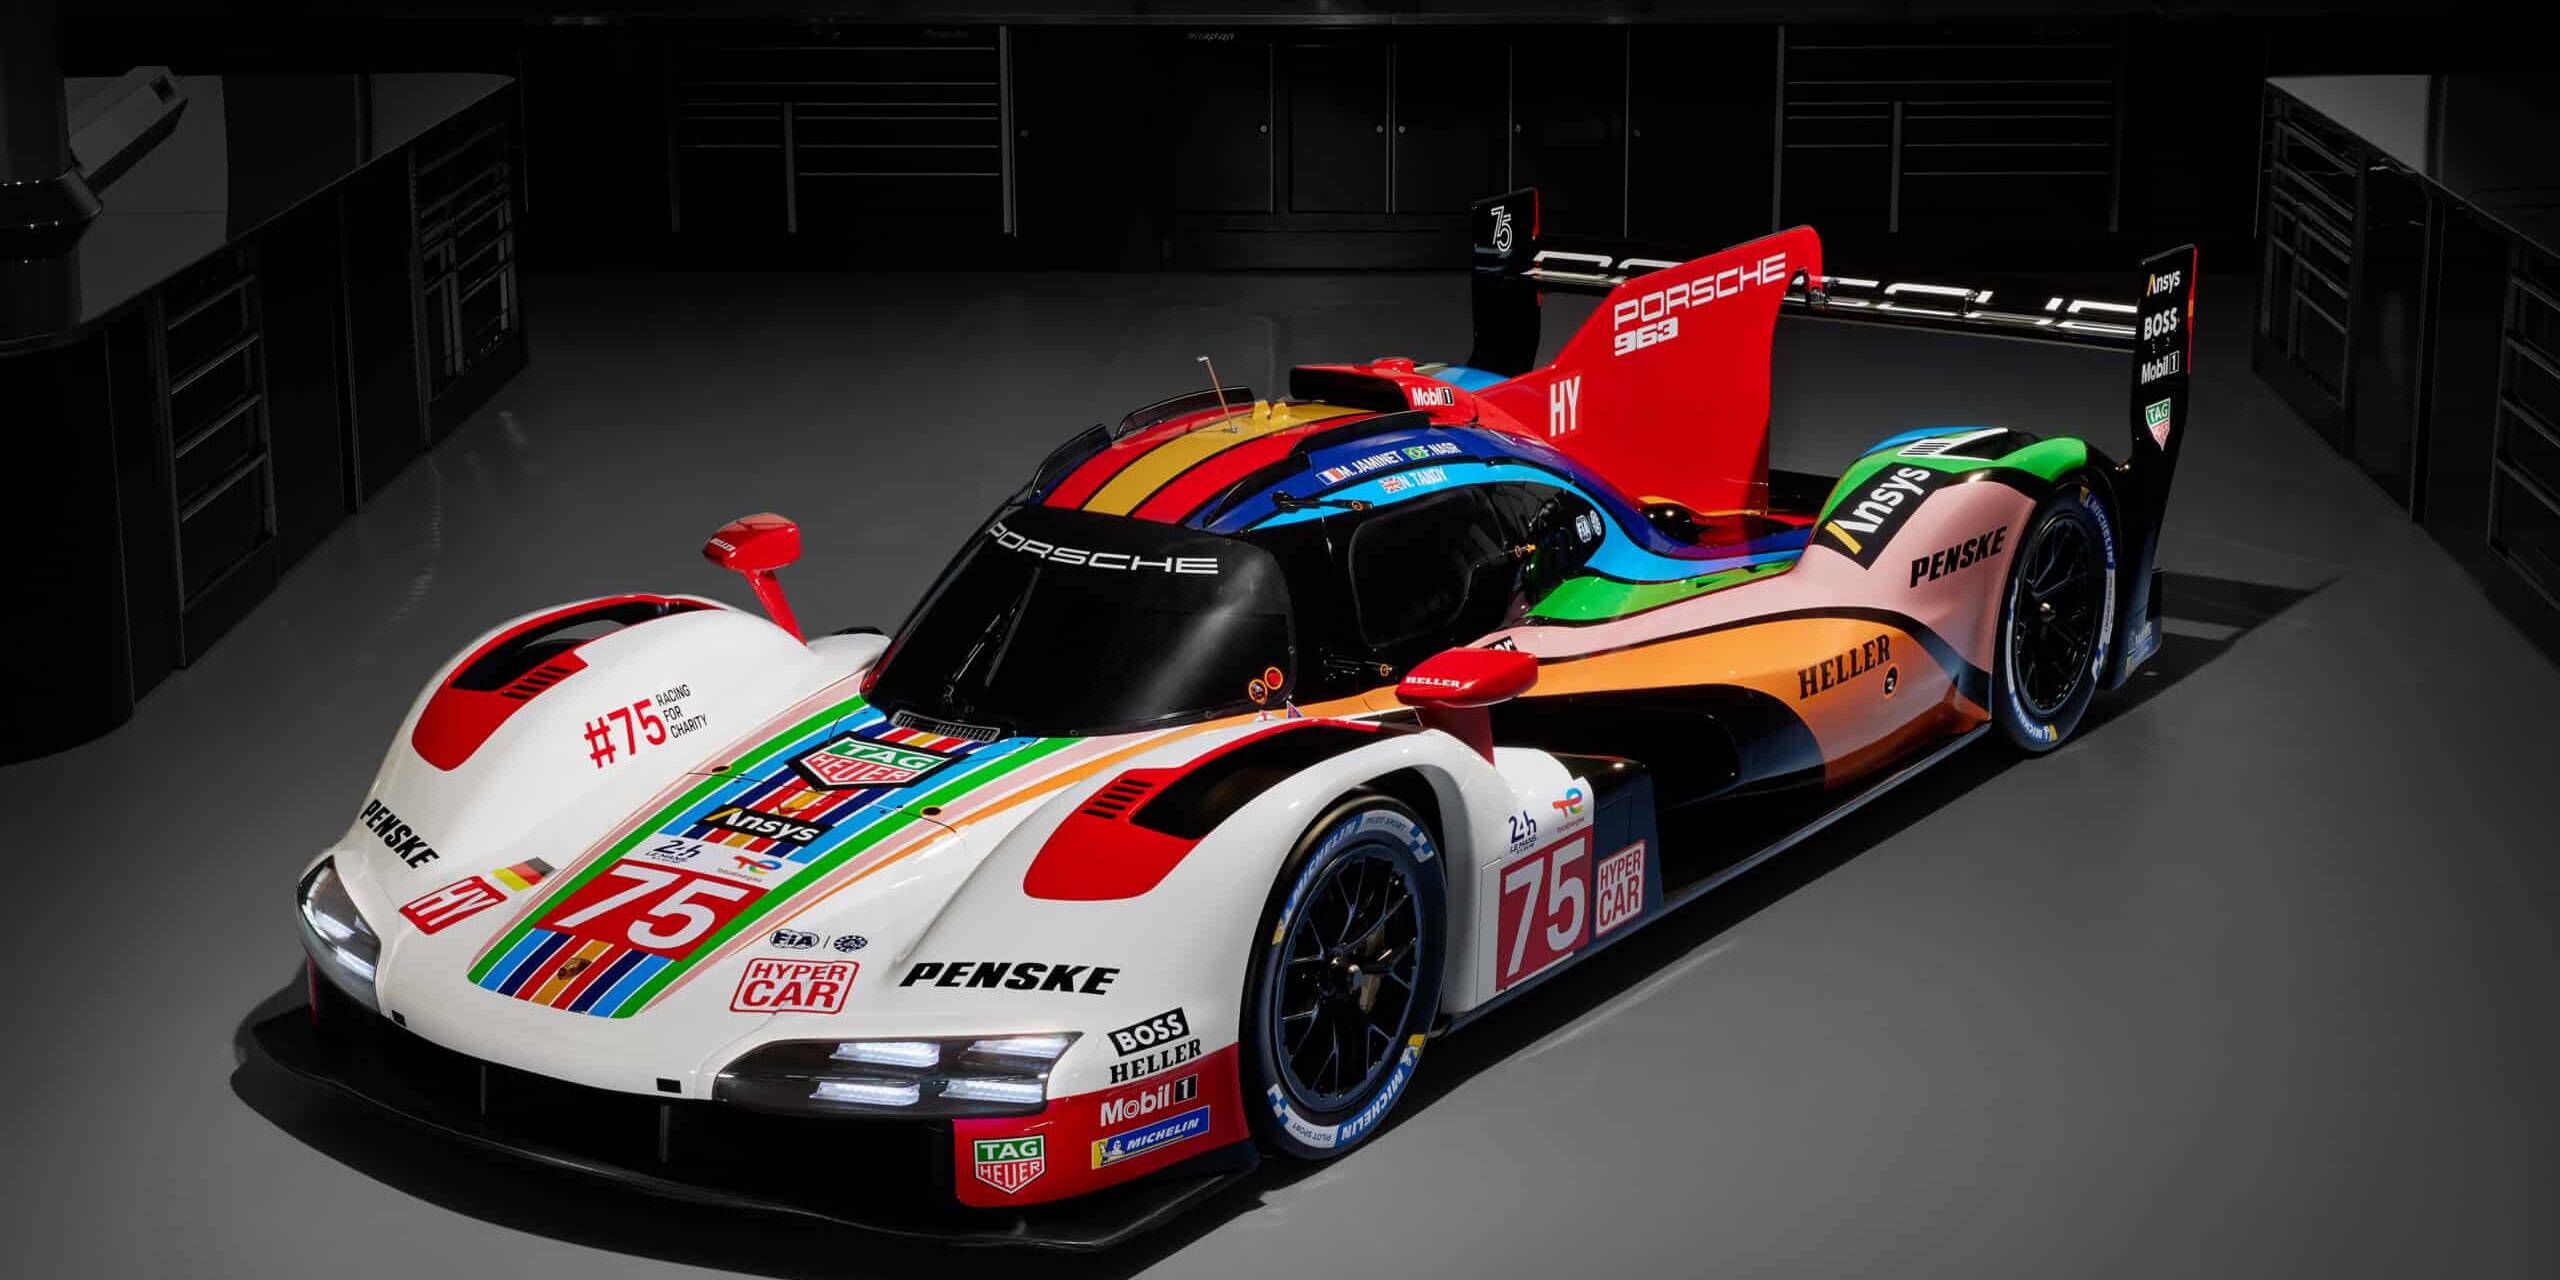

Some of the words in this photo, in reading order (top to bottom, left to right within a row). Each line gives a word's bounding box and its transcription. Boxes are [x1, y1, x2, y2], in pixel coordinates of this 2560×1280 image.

[1490, 205, 1513, 252] 75
[1613, 252, 1786, 332] PORSCHE
[2146, 270, 2181, 297] Ansys
[1614, 316, 1679, 357] 963
[2143, 307, 2178, 342] BOSS
[2141, 353, 2168, 386] Mobil
[1411, 387, 1442, 407] Mobil
[1550, 375, 1581, 437] HY
[2148, 403, 2169, 423] TAG
[1352, 450, 1403, 474] JAMINET
[1825, 466, 1931, 555] Ansys
[985, 521, 1219, 574] PORSCHE
[1910, 526, 2008, 589] PENSKE
[1405, 675, 1461, 688] HELLER
[1797, 633, 1892, 700] HELLER
[655, 683, 691, 707] RACING
[662, 705, 684, 723] FOR
[669, 713, 708, 739] CHARITY
[583, 698, 667, 769] #75
[811, 753, 917, 783] HEUER
[843, 742, 934, 770] TAG
[359, 799, 441, 869] PENSKE
[704, 807, 821, 842] Ansys
[1600, 850, 1642, 891] HYPER
[407, 879, 498, 927] HY
[552, 864, 751, 950] 75
[1505, 837, 1585, 978] 75
[1599, 875, 1640, 927] CAR
[771, 931, 814, 947] FIA
[751, 962, 848, 982] HYPER
[898, 961, 1121, 996] PENSKE
[742, 979, 840, 1008] CAR
[1115, 1013, 1184, 1053] BOSS
[1110, 1038, 1202, 1085] HELLER
[1099, 1083, 1171, 1128] Mobil
[1341, 1067, 1404, 1141] MICHELIN
[979, 1140, 1038, 1160] TAG
[1126, 1117, 1200, 1151] MICHELIN
[980, 1160, 1040, 1189] HEUER
